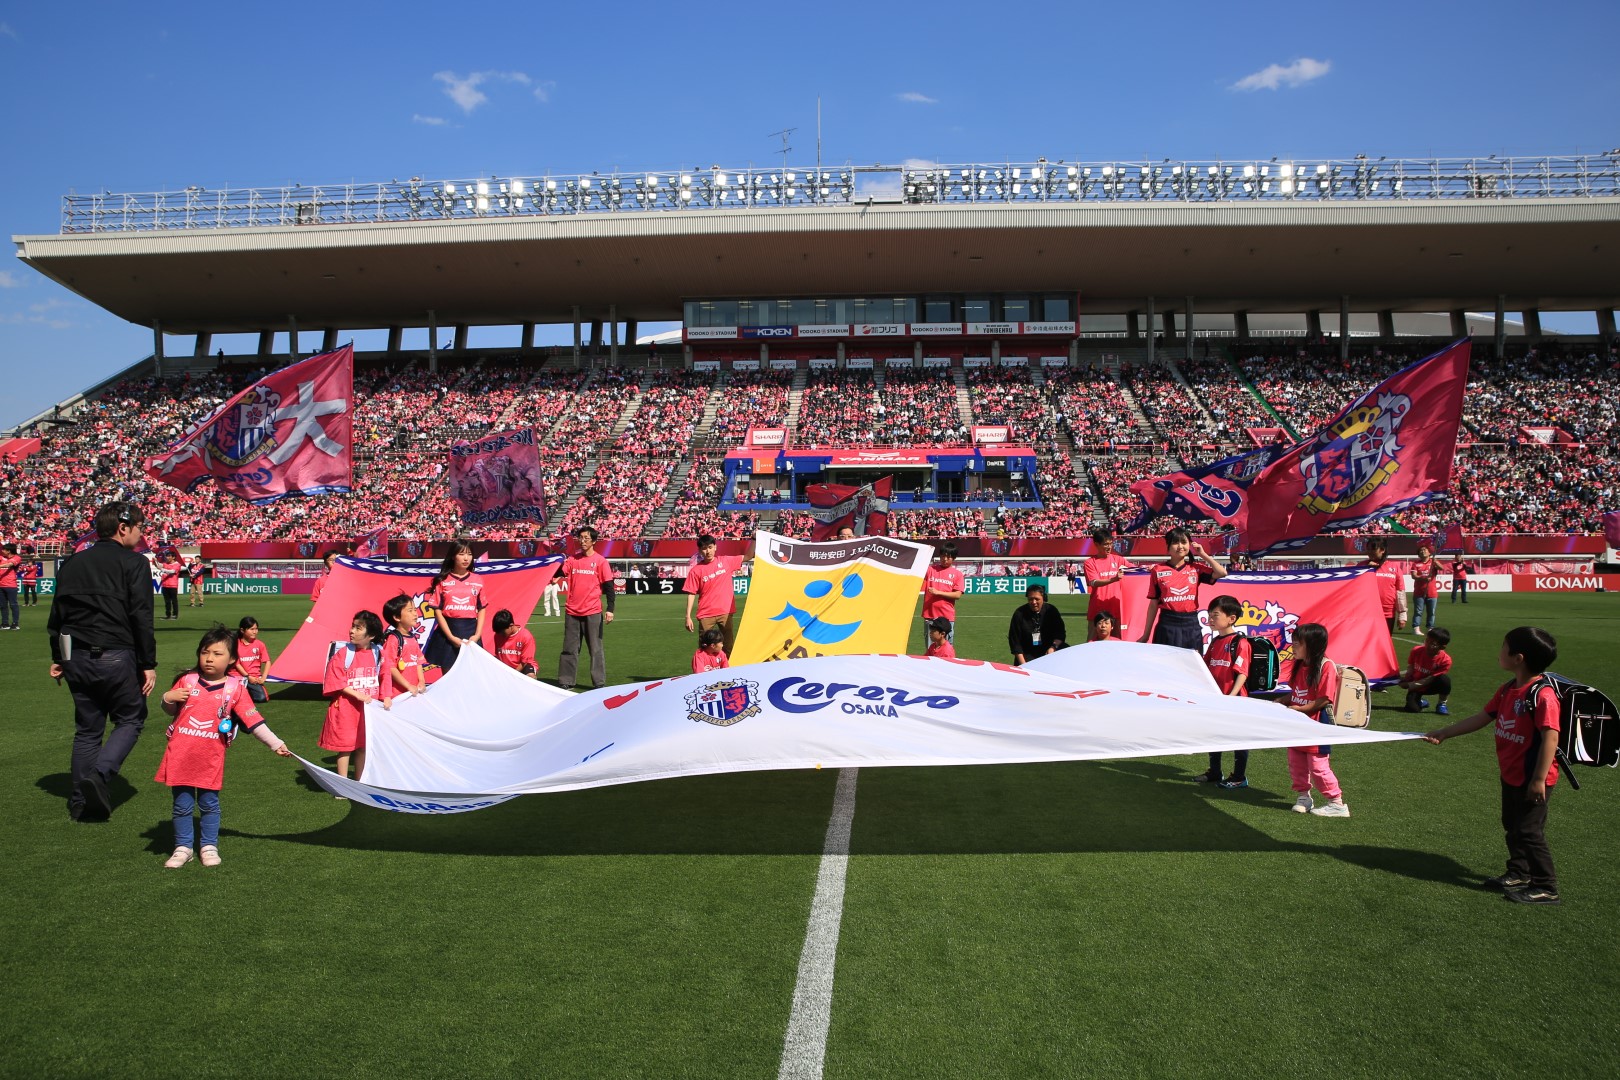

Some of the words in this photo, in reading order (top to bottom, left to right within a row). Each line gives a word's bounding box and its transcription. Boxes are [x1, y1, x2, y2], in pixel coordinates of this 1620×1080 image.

[757, 328, 792, 336] KOKEN
[809, 550, 846, 560] 明治安田
[850, 544, 899, 559] J.LEAGUE
[245, 585, 278, 593] HOTELS
[1535, 576, 1603, 589] KONAMI
[1163, 594, 1196, 603] YANMAR
[767, 676, 960, 714] Cerezo
[840, 702, 899, 718] OSAKA
[178, 726, 220, 740] YANMAR
